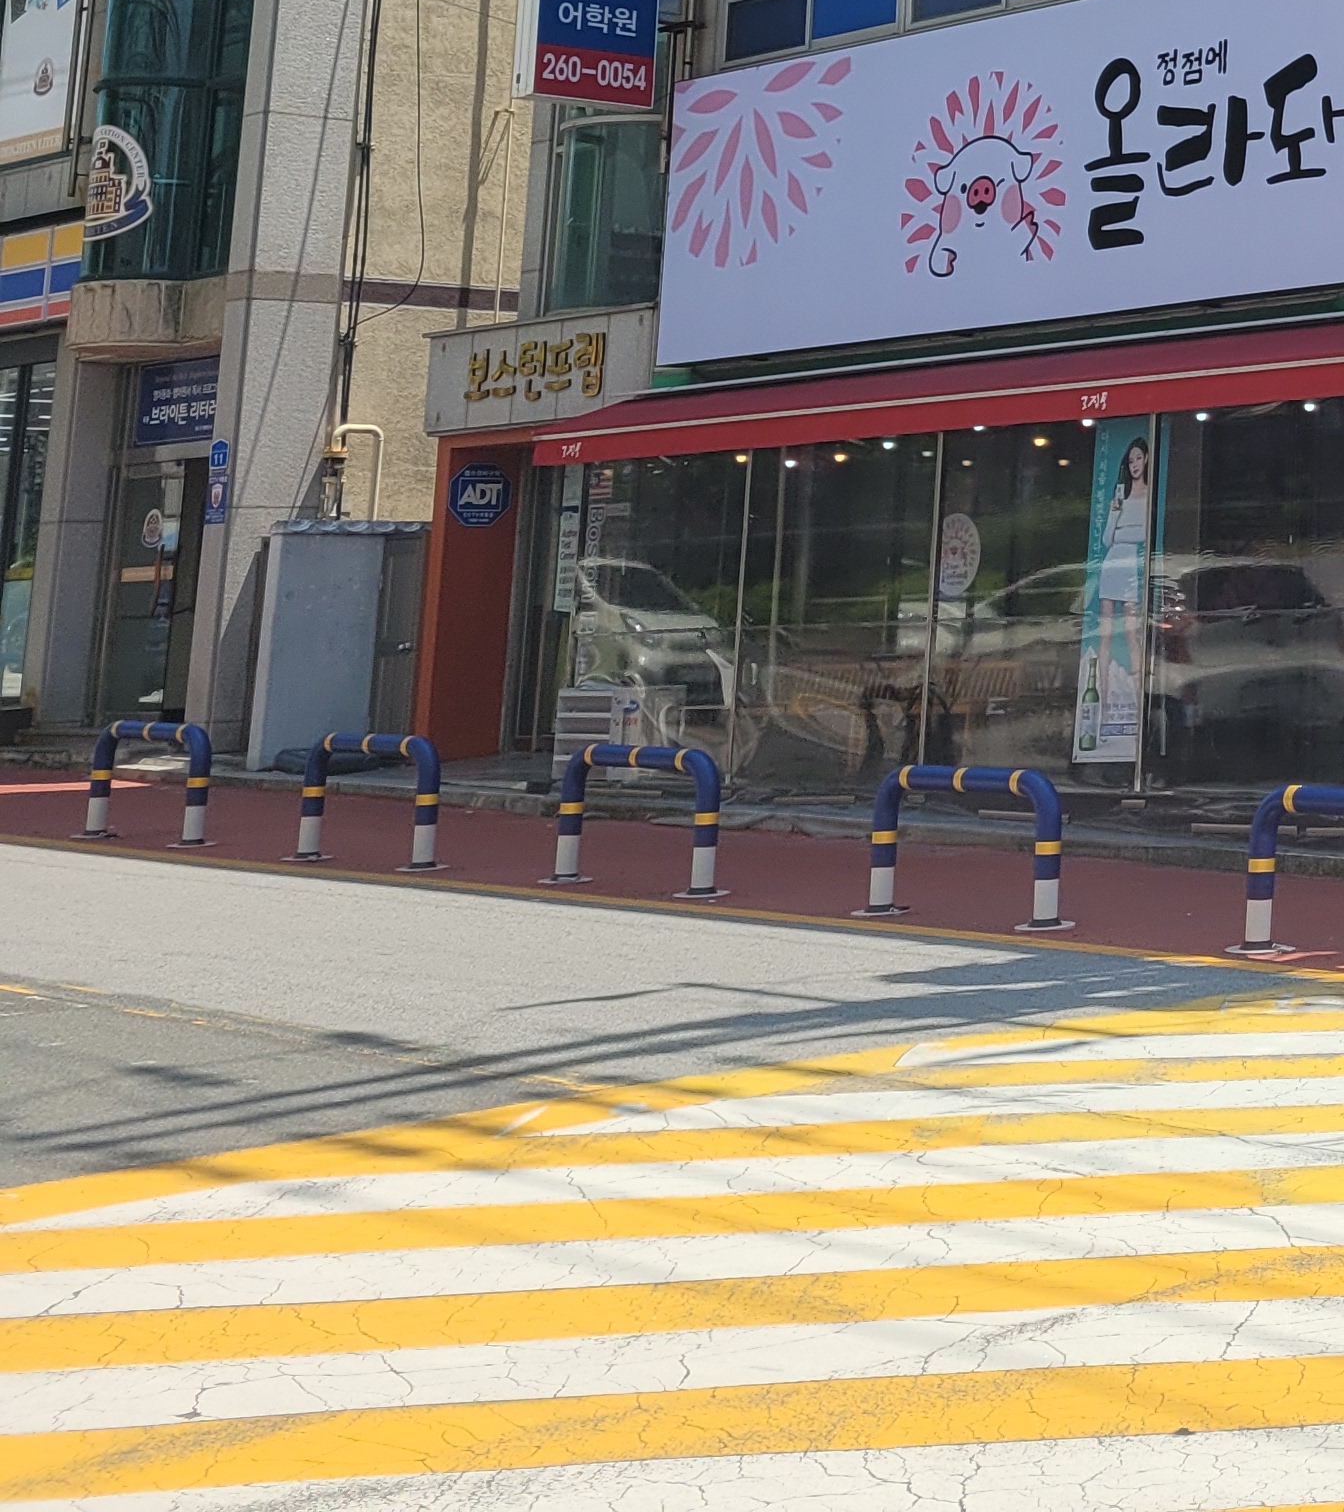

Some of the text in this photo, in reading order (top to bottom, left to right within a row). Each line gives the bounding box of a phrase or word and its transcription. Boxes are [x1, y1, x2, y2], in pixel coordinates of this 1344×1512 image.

[557, 0, 638, 38] 어학원
[541, 51, 647, 92] 260-0054
[1156, 38, 1229, 87] 정점에
[463, 332, 607, 402] 보스턴프렙
[213, 453, 225, 466] 11
[459, 483, 502, 506] ADT
